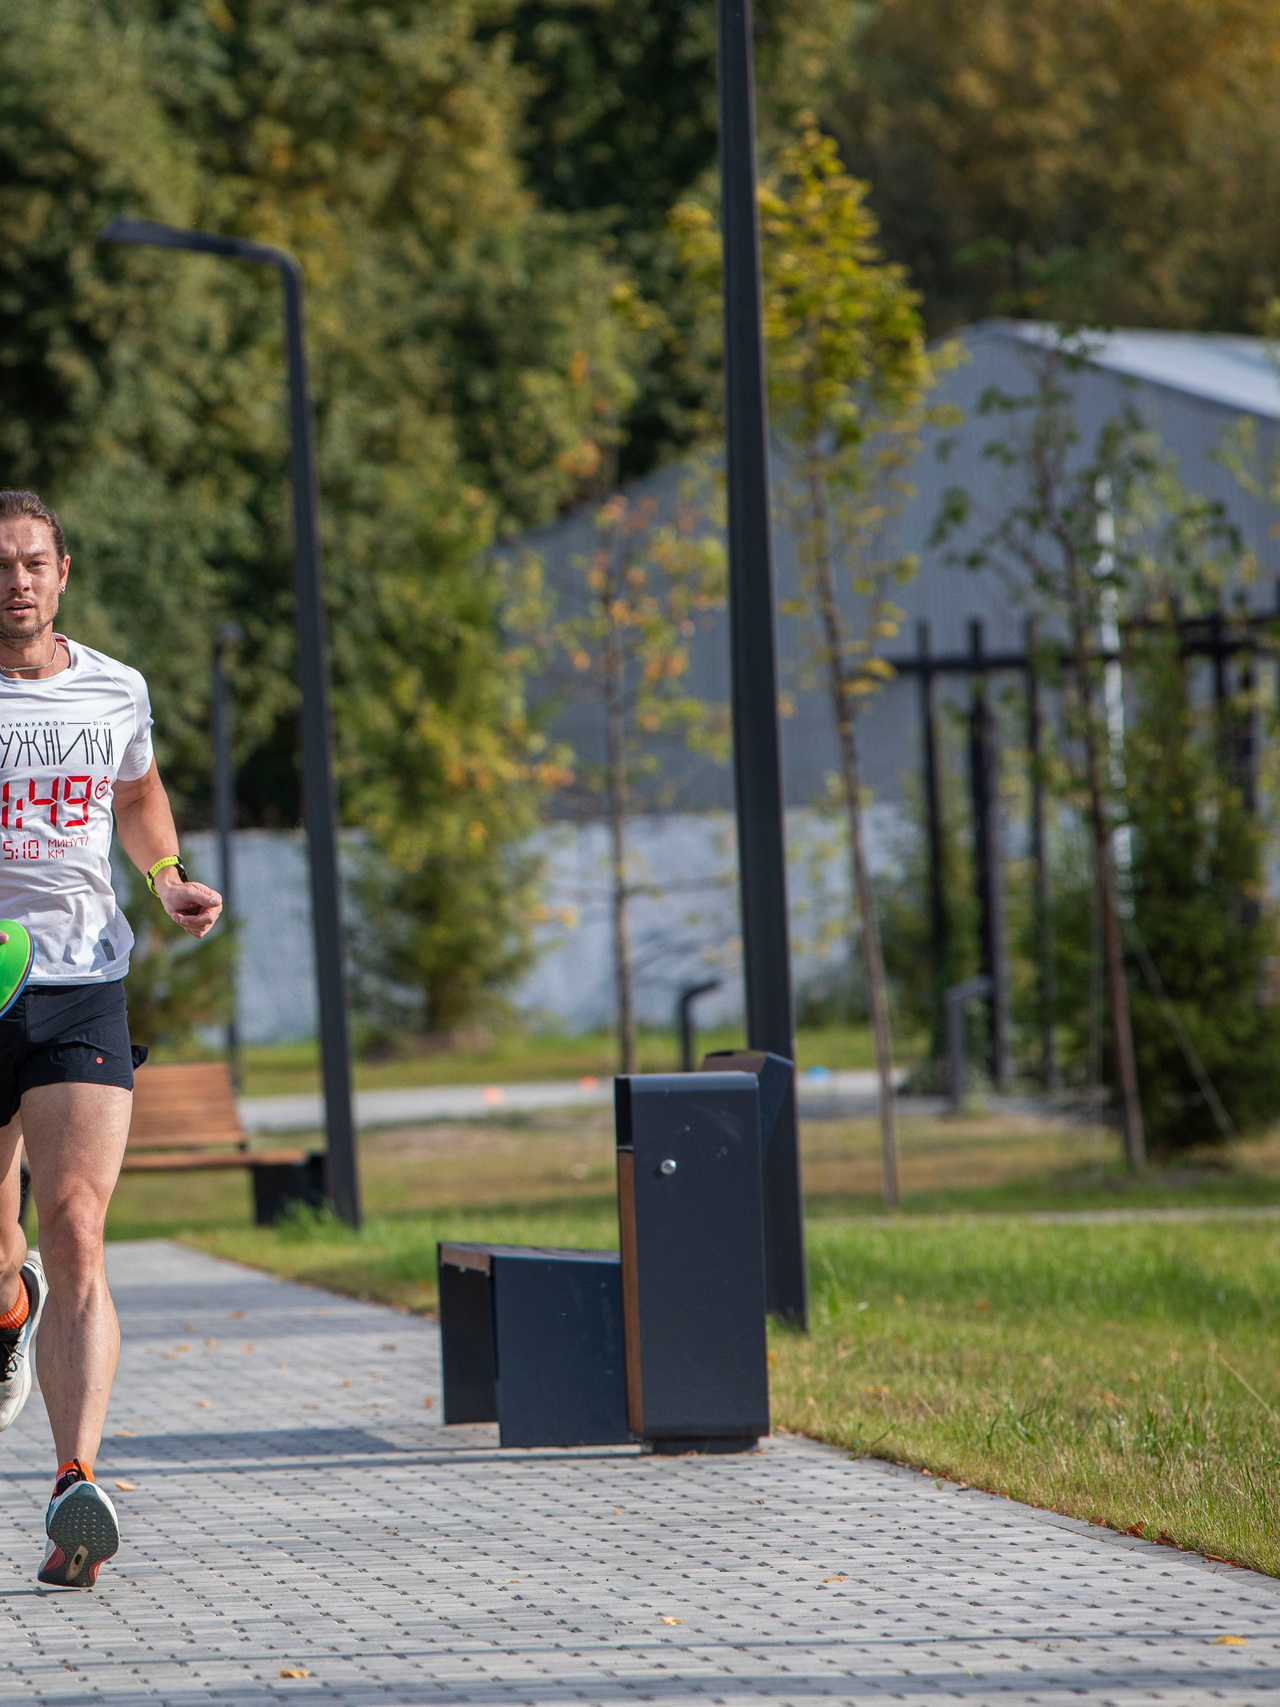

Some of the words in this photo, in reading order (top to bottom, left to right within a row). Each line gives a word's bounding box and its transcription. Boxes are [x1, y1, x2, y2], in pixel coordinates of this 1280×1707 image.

[1, 775, 93, 830] 1:49
[2, 840, 40, 860] 5:10
[47, 849, 65, 859] КМ
